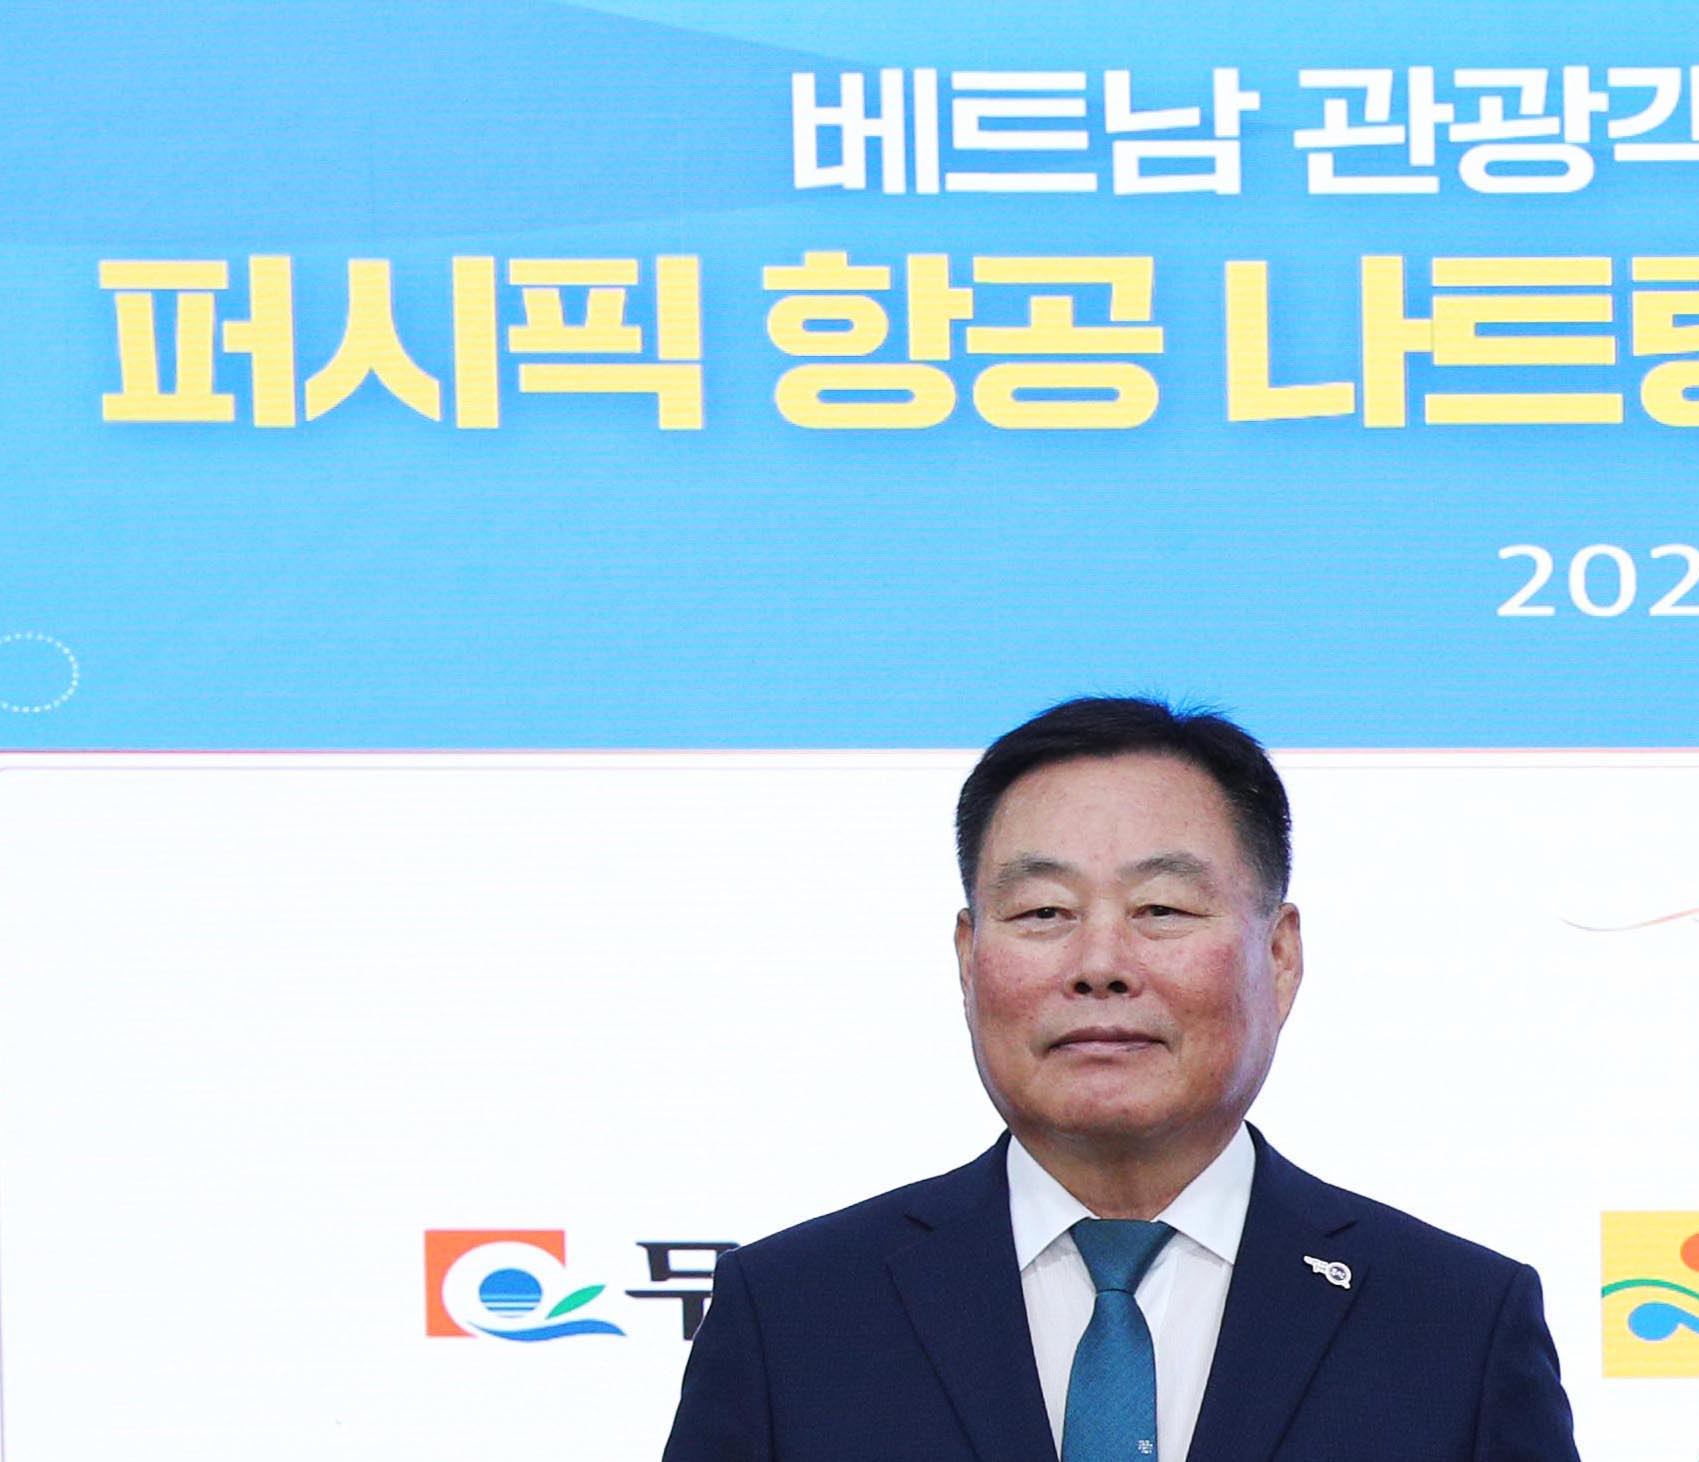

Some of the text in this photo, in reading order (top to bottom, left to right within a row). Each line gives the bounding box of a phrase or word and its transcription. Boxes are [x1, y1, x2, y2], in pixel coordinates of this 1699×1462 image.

[792, 68, 1260, 194] 베트남
[98, 254, 704, 430] 퍼시픽
[763, 251, 1163, 428] 항공
